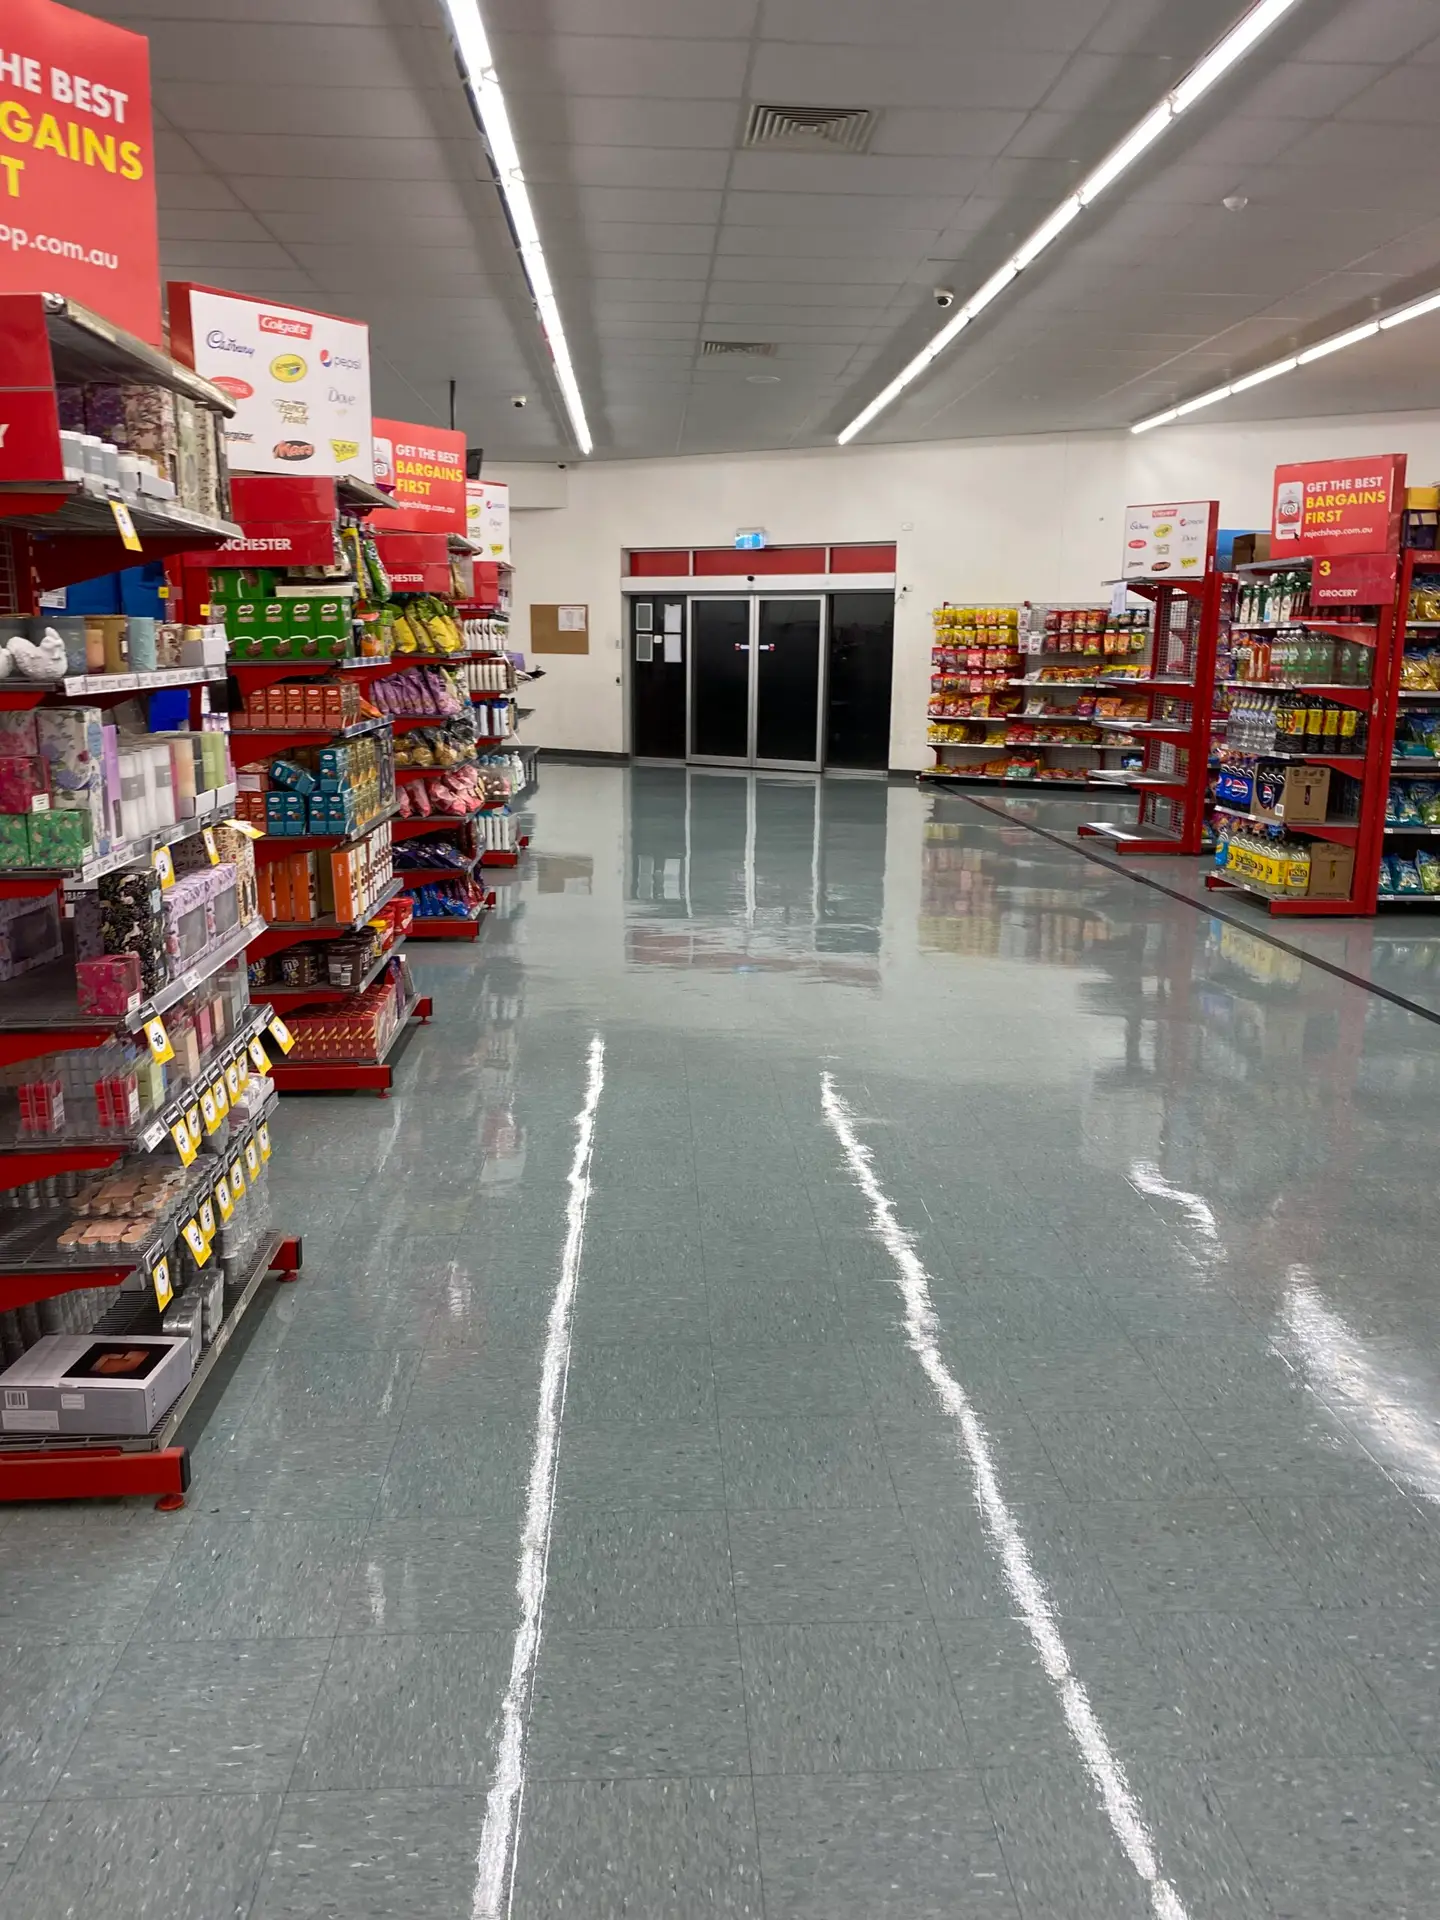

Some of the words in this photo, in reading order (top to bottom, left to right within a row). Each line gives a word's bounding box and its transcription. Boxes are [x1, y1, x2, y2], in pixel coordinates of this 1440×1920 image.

[50, 66, 129, 124] BEST
[260, 317, 308, 334] Colgate
[396, 443, 417, 457] GET
[417, 446, 437, 461] THE
[437, 450, 460, 465] BEST
[396, 459, 464, 482] BARGAINS
[396, 478, 431, 496] FIRST
[1306, 481, 1329, 493] GET
[1330, 478, 1352, 491] THE
[1354, 476, 1383, 489] BEST
[1306, 490, 1387, 509] BARGAINS
[1305, 509, 1344, 525] FIRST
[1318, 560, 1332, 577] 3
[1318, 588, 1359, 598] GROCERY
